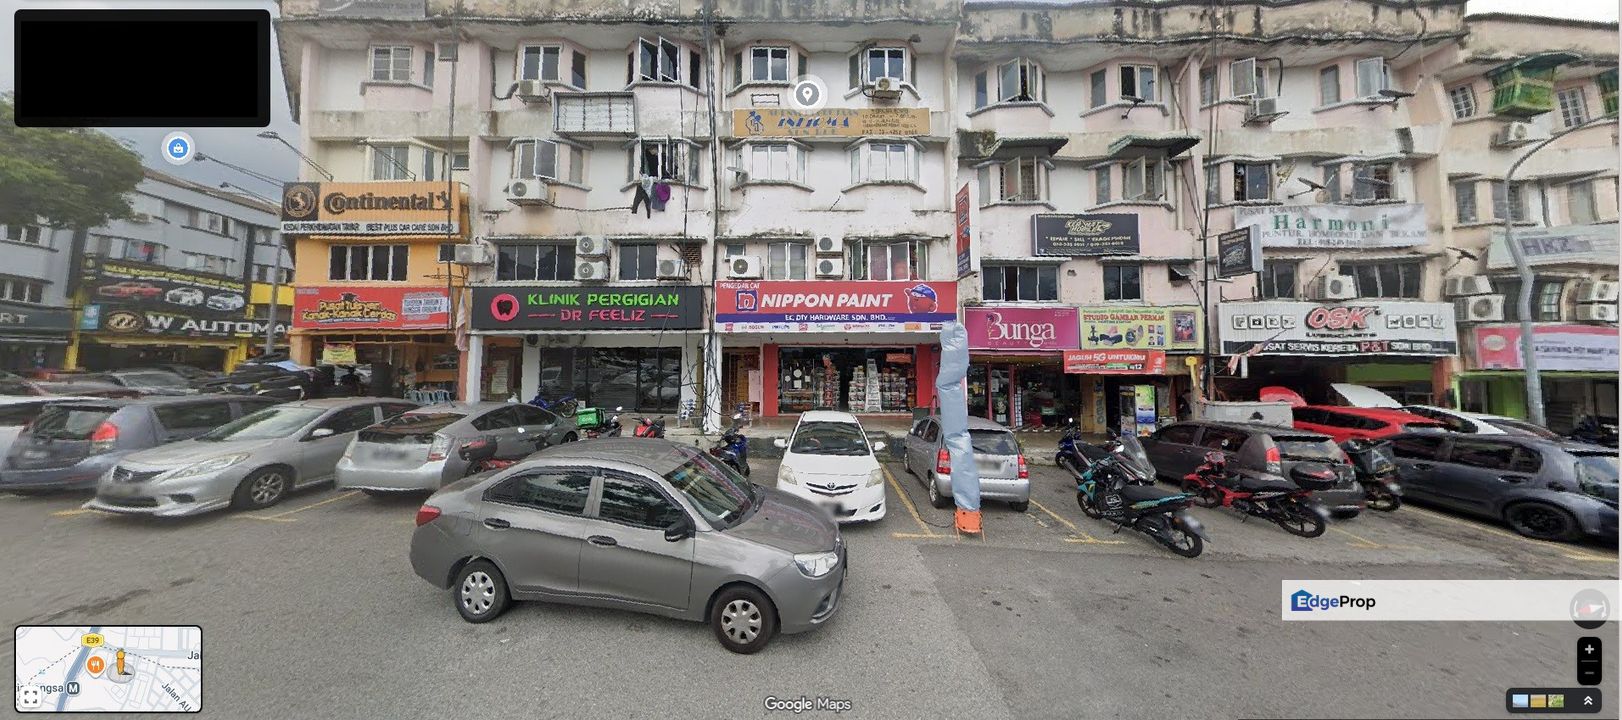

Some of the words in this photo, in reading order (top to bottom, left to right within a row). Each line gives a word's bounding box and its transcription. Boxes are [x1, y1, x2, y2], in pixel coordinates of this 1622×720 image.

[323, 192, 433, 216] Continental
[365, 223, 382, 232] BEST
[384, 223, 397, 232] PLUS
[399, 223, 410, 231] CAR
[411, 223, 426, 231] CARE
[1273, 213, 1390, 232] Harmoni
[527, 294, 580, 306] KLINIK
[588, 293, 679, 307] PERGIGIAN
[760, 293, 833, 309] NIPPON
[836, 293, 893, 308] PAINT
[560, 309, 582, 321] DR
[589, 309, 645, 321] FEELIZ
[1306, 307, 1374, 331] OSK
[146, 313, 174, 330] W
[180, 318, 294, 334] AUTOMA
[988, 311, 1057, 348] Bunga
[1287, 343, 1320, 352] SERVIS
[1321, 343, 1360, 353] KERETA
[1360, 340, 1389, 352] P&T
[1391, 342, 1410, 350] SDN
[1093, 354, 1106, 362] 5G
[1108, 354, 1147, 362] UNTUKMU
